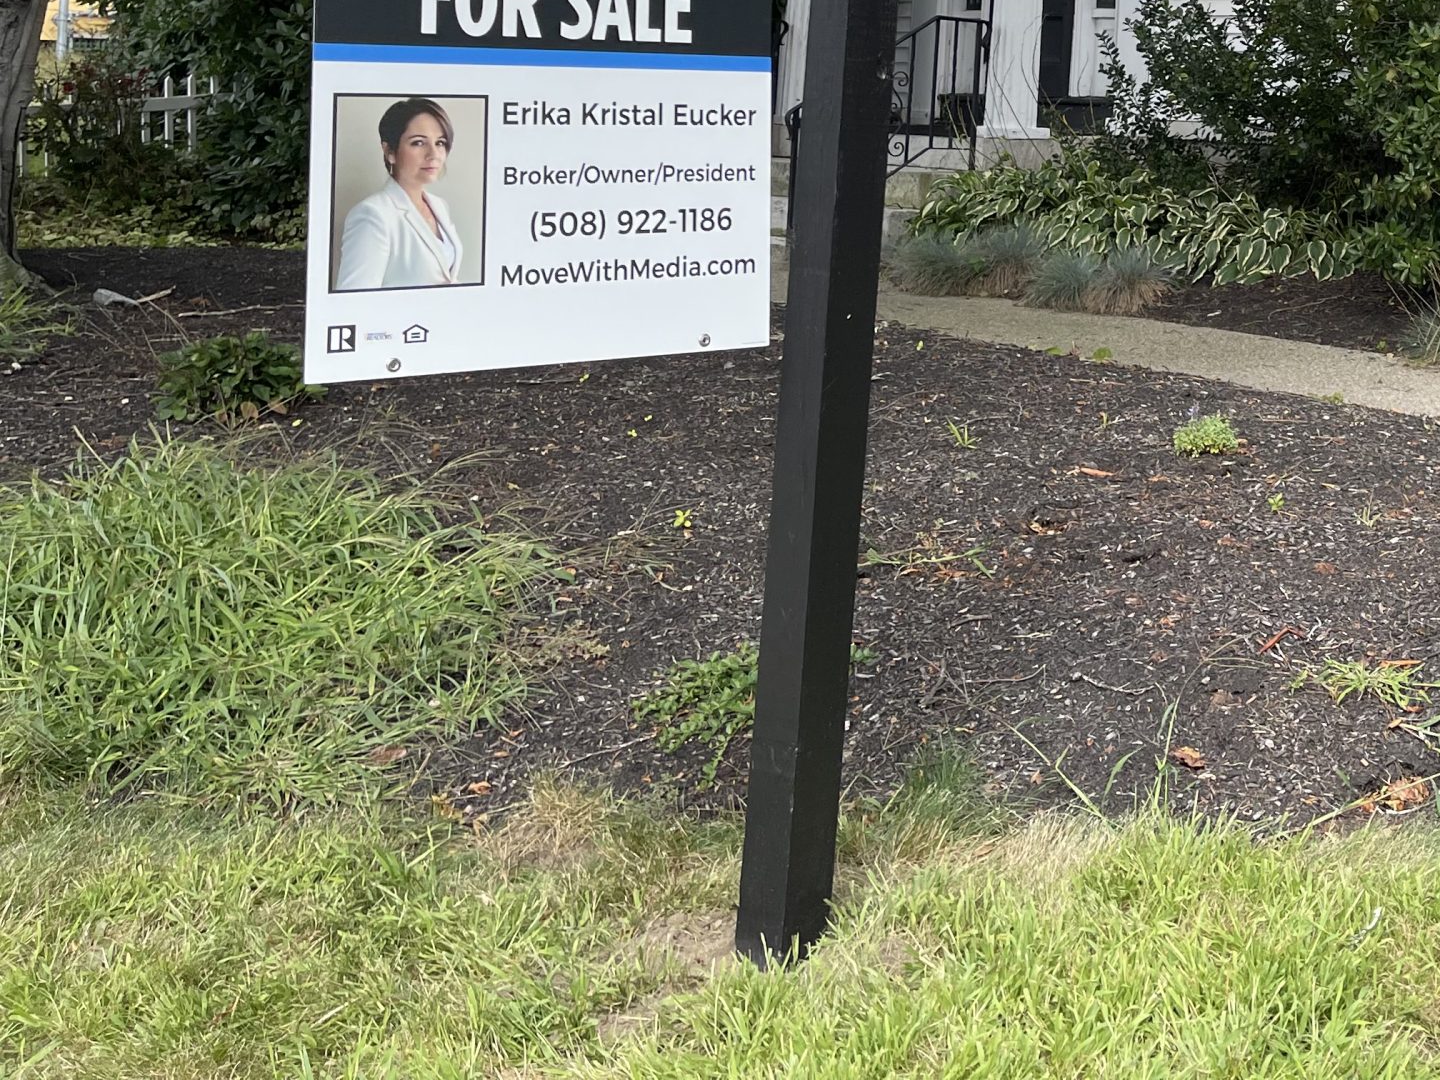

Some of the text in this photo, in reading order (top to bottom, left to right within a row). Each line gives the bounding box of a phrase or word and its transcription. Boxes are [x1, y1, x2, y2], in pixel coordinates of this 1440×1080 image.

[502, 101, 757, 127] Erika Kristal Eucker
[503, 162, 757, 188] Broker/Owner/President
[529, 207, 733, 242] (508) 922-1186
[500, 255, 757, 287] MoveWithMedia.com
